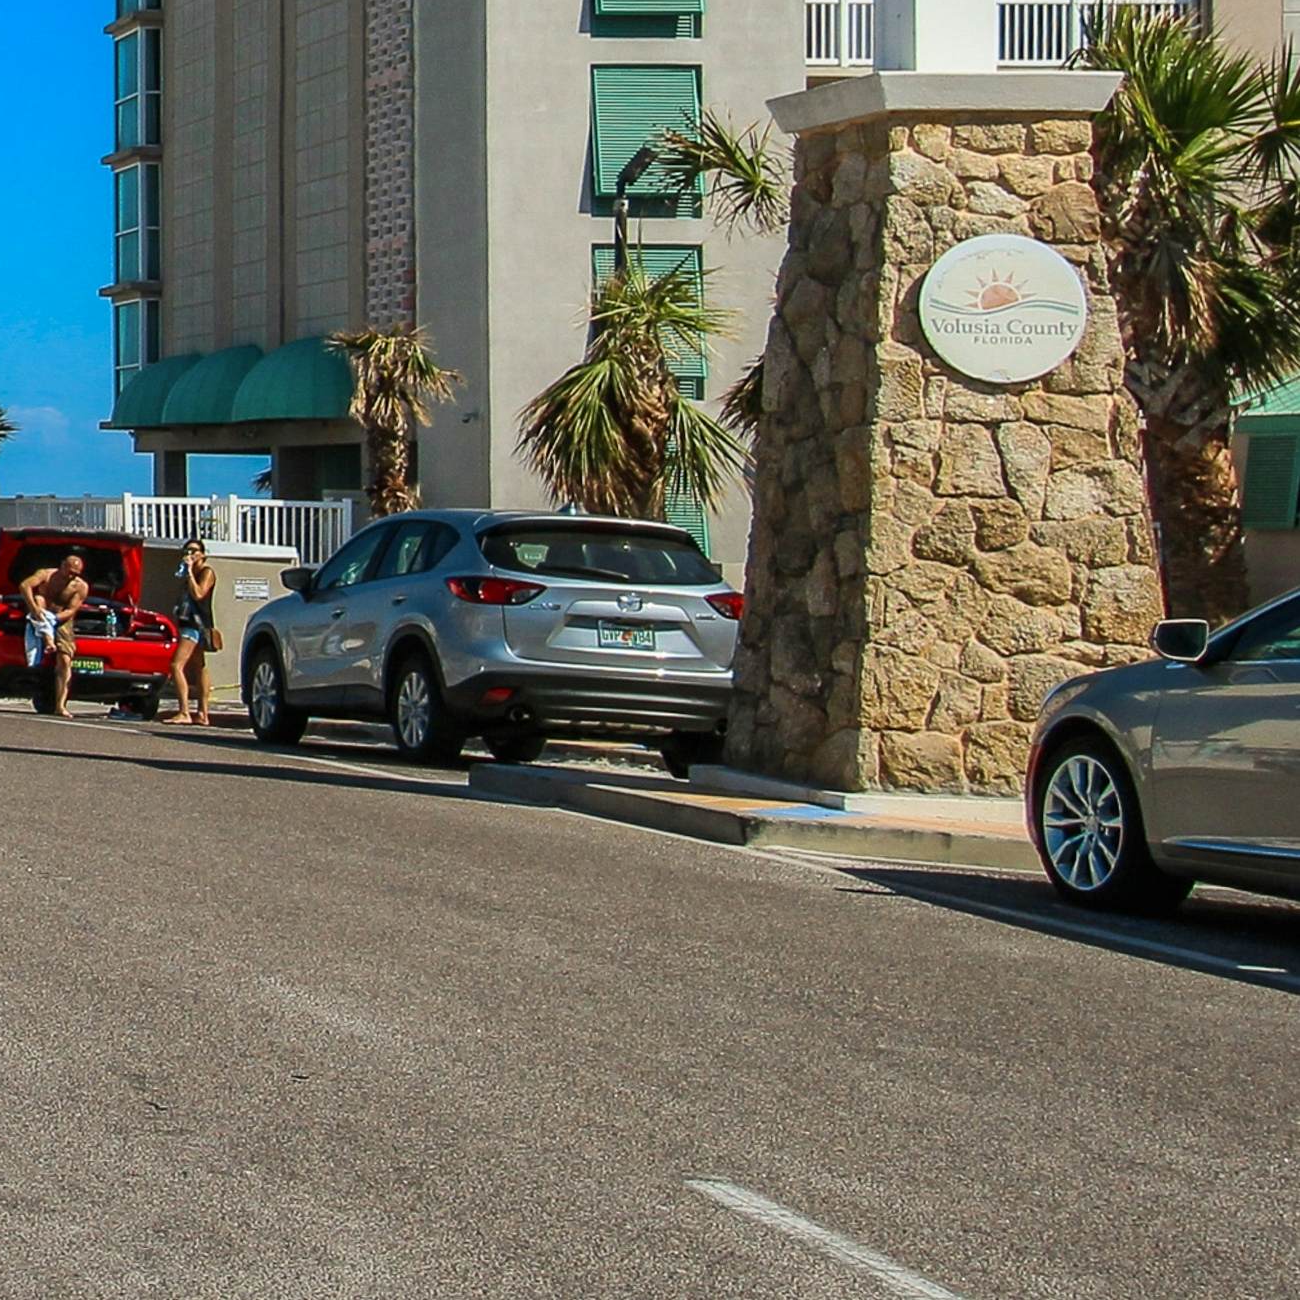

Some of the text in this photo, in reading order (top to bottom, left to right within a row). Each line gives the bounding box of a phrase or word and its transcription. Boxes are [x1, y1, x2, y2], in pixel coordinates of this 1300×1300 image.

[931, 318, 1078, 341] Volusia County
[973, 335, 1033, 345] FLORIDA
